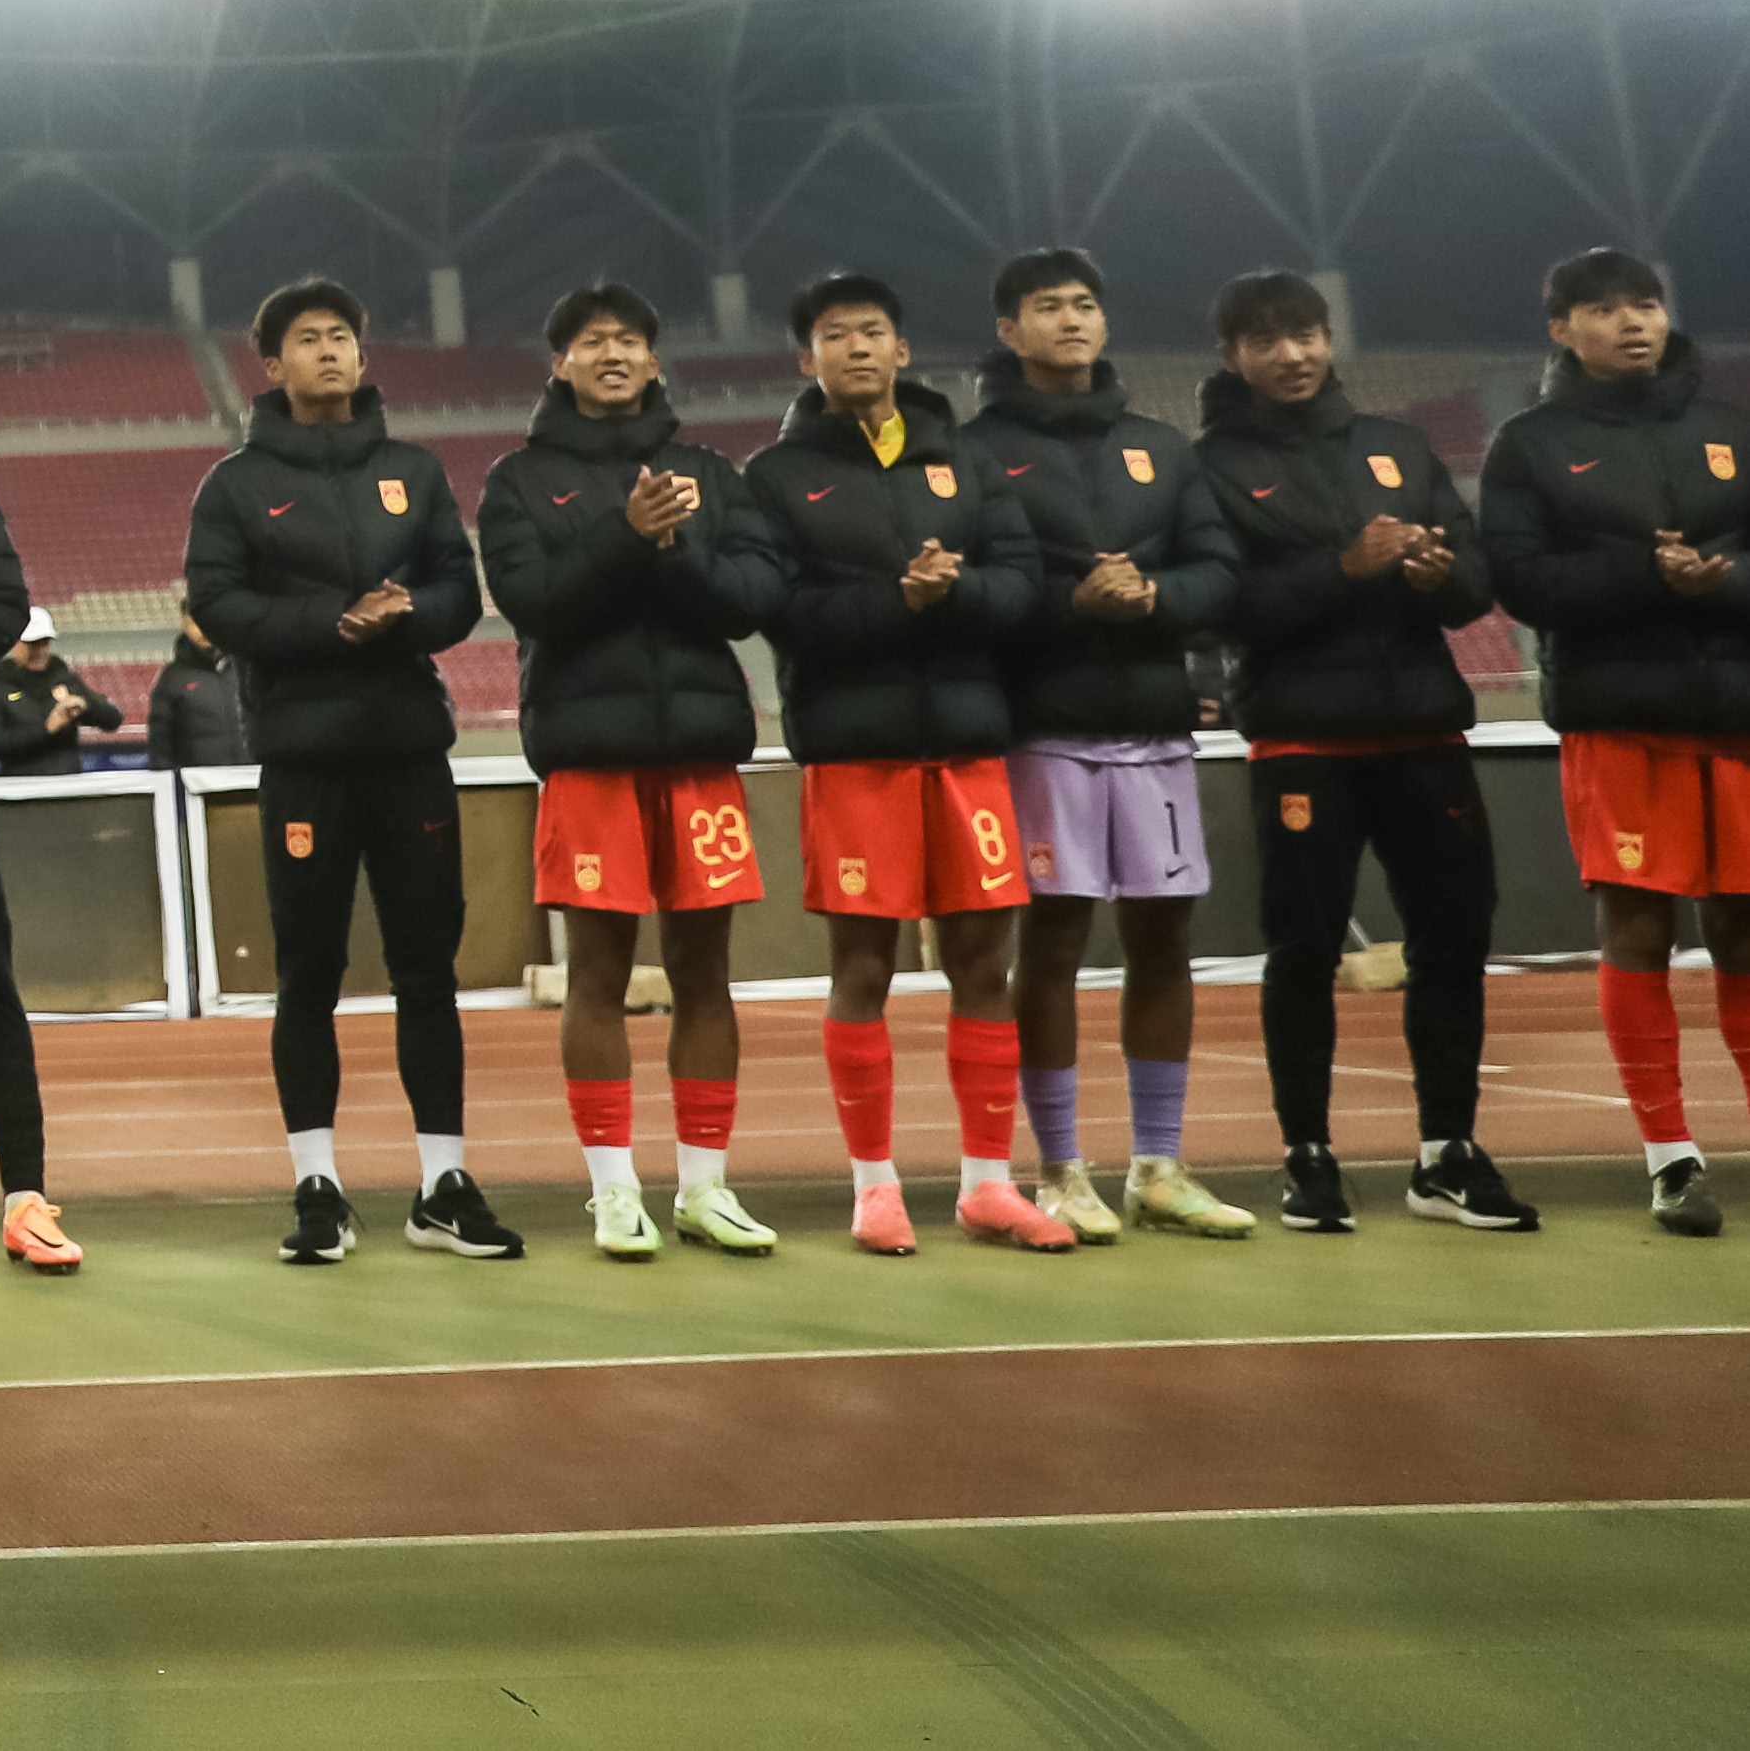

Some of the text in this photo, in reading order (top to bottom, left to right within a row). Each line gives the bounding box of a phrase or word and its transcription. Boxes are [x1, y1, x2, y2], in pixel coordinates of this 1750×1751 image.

[689, 804, 750, 866] 23
[972, 808, 1007, 866] 8
[1164, 801, 1180, 855] 1
